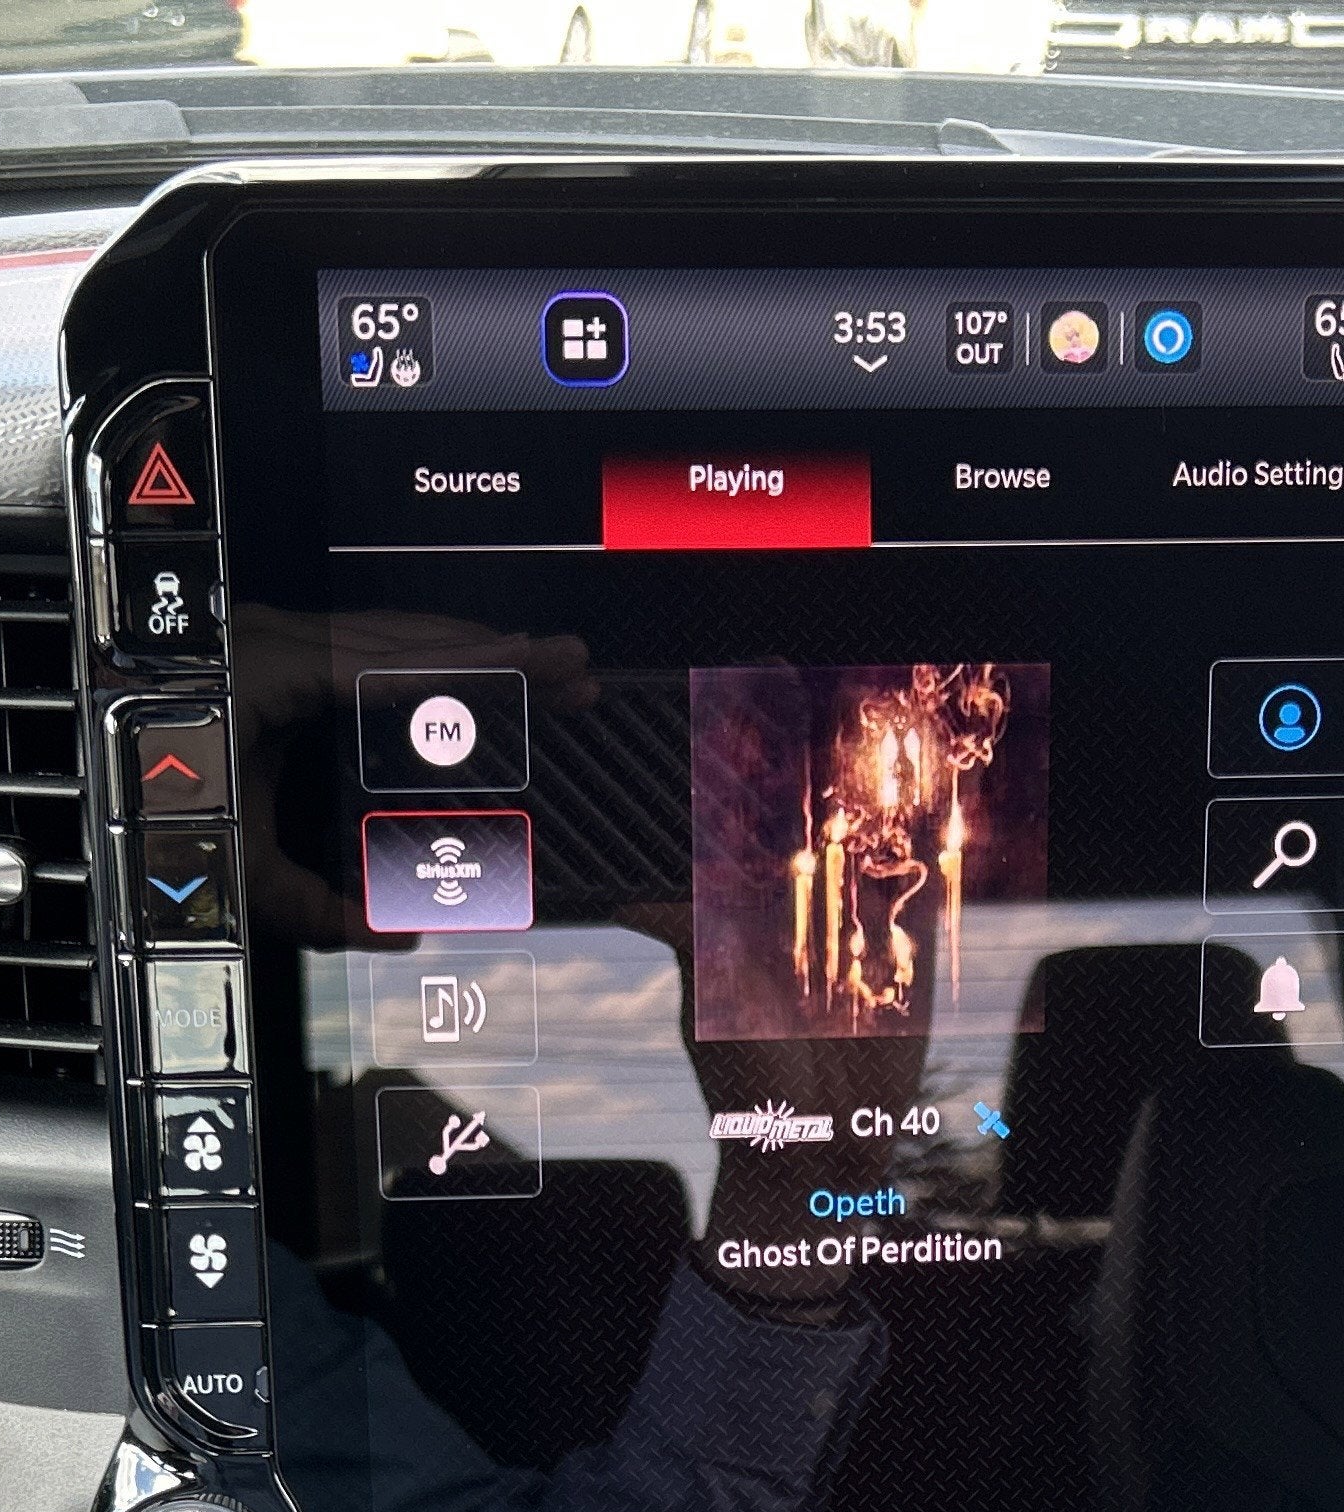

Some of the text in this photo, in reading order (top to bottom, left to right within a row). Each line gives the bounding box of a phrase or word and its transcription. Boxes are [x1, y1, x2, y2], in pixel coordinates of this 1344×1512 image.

[833, 311, 906, 345] 3:53
[955, 342, 1004, 365] OUT
[414, 466, 521, 493] Sources
[688, 463, 786, 497] Playing
[955, 463, 1051, 490] Browse
[1172, 459, 1248, 487] Audio
[148, 614, 189, 635] OFF
[422, 719, 463, 744] FM
[156, 1009, 222, 1028] MODE
[850, 1105, 941, 1137] Ch 40
[809, 1186, 907, 1223] Opeth
[717, 1232, 1002, 1269] Ghost Of Perdition
[183, 1374, 243, 1395] AUTO
